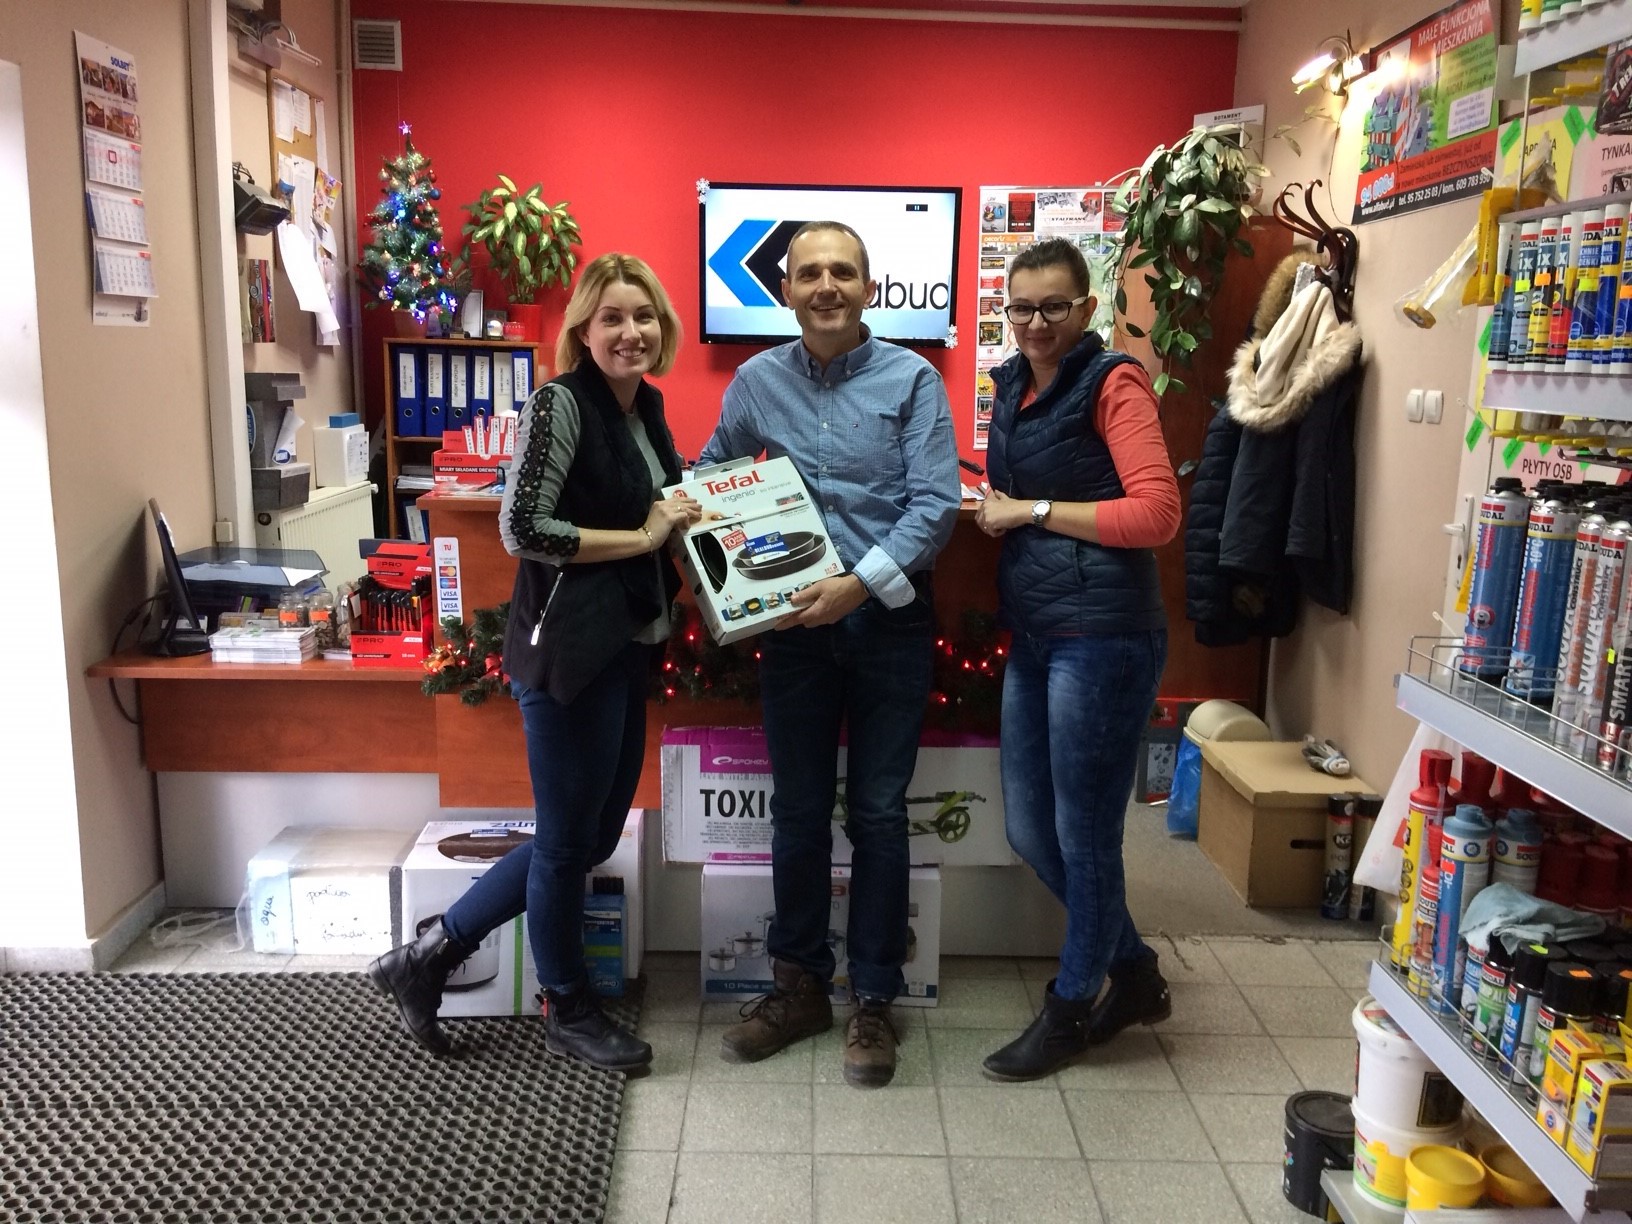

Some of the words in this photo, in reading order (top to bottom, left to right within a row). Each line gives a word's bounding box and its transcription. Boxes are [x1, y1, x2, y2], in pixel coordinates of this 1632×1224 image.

[1418, 22, 1439, 47] MAŁE
[1432, 19, 1484, 57] MIESZKANIA
[1214, 112, 1242, 121] BOTAMENT
[1602, 141, 1632, 161] TYNKA
[1407, 193, 1414, 204] 95
[1414, 191, 1424, 202] 752
[1424, 189, 1431, 200] 25
[1431, 187, 1438, 198] 03
[1442, 183, 1455, 195] kom.
[1455, 179, 1467, 192] 609
[1467, 176, 1479, 188] 783
[1541, 235, 1556, 244] DAL
[1538, 248, 1552, 266] ix
[1580, 246, 1600, 255] CHNIE
[1519, 253, 1534, 270] ix
[1522, 458, 1551, 478] PŁYTY
[1552, 462, 1573, 480] OSB
[701, 470, 765, 496] Tefal
[721, 489, 756, 504] ingenio
[724, 538, 736, 548] 10
[1570, 556, 1584, 610] CONSTRUCT
[1608, 650, 1632, 722] SMART
[700, 788, 772, 819] TOXI
